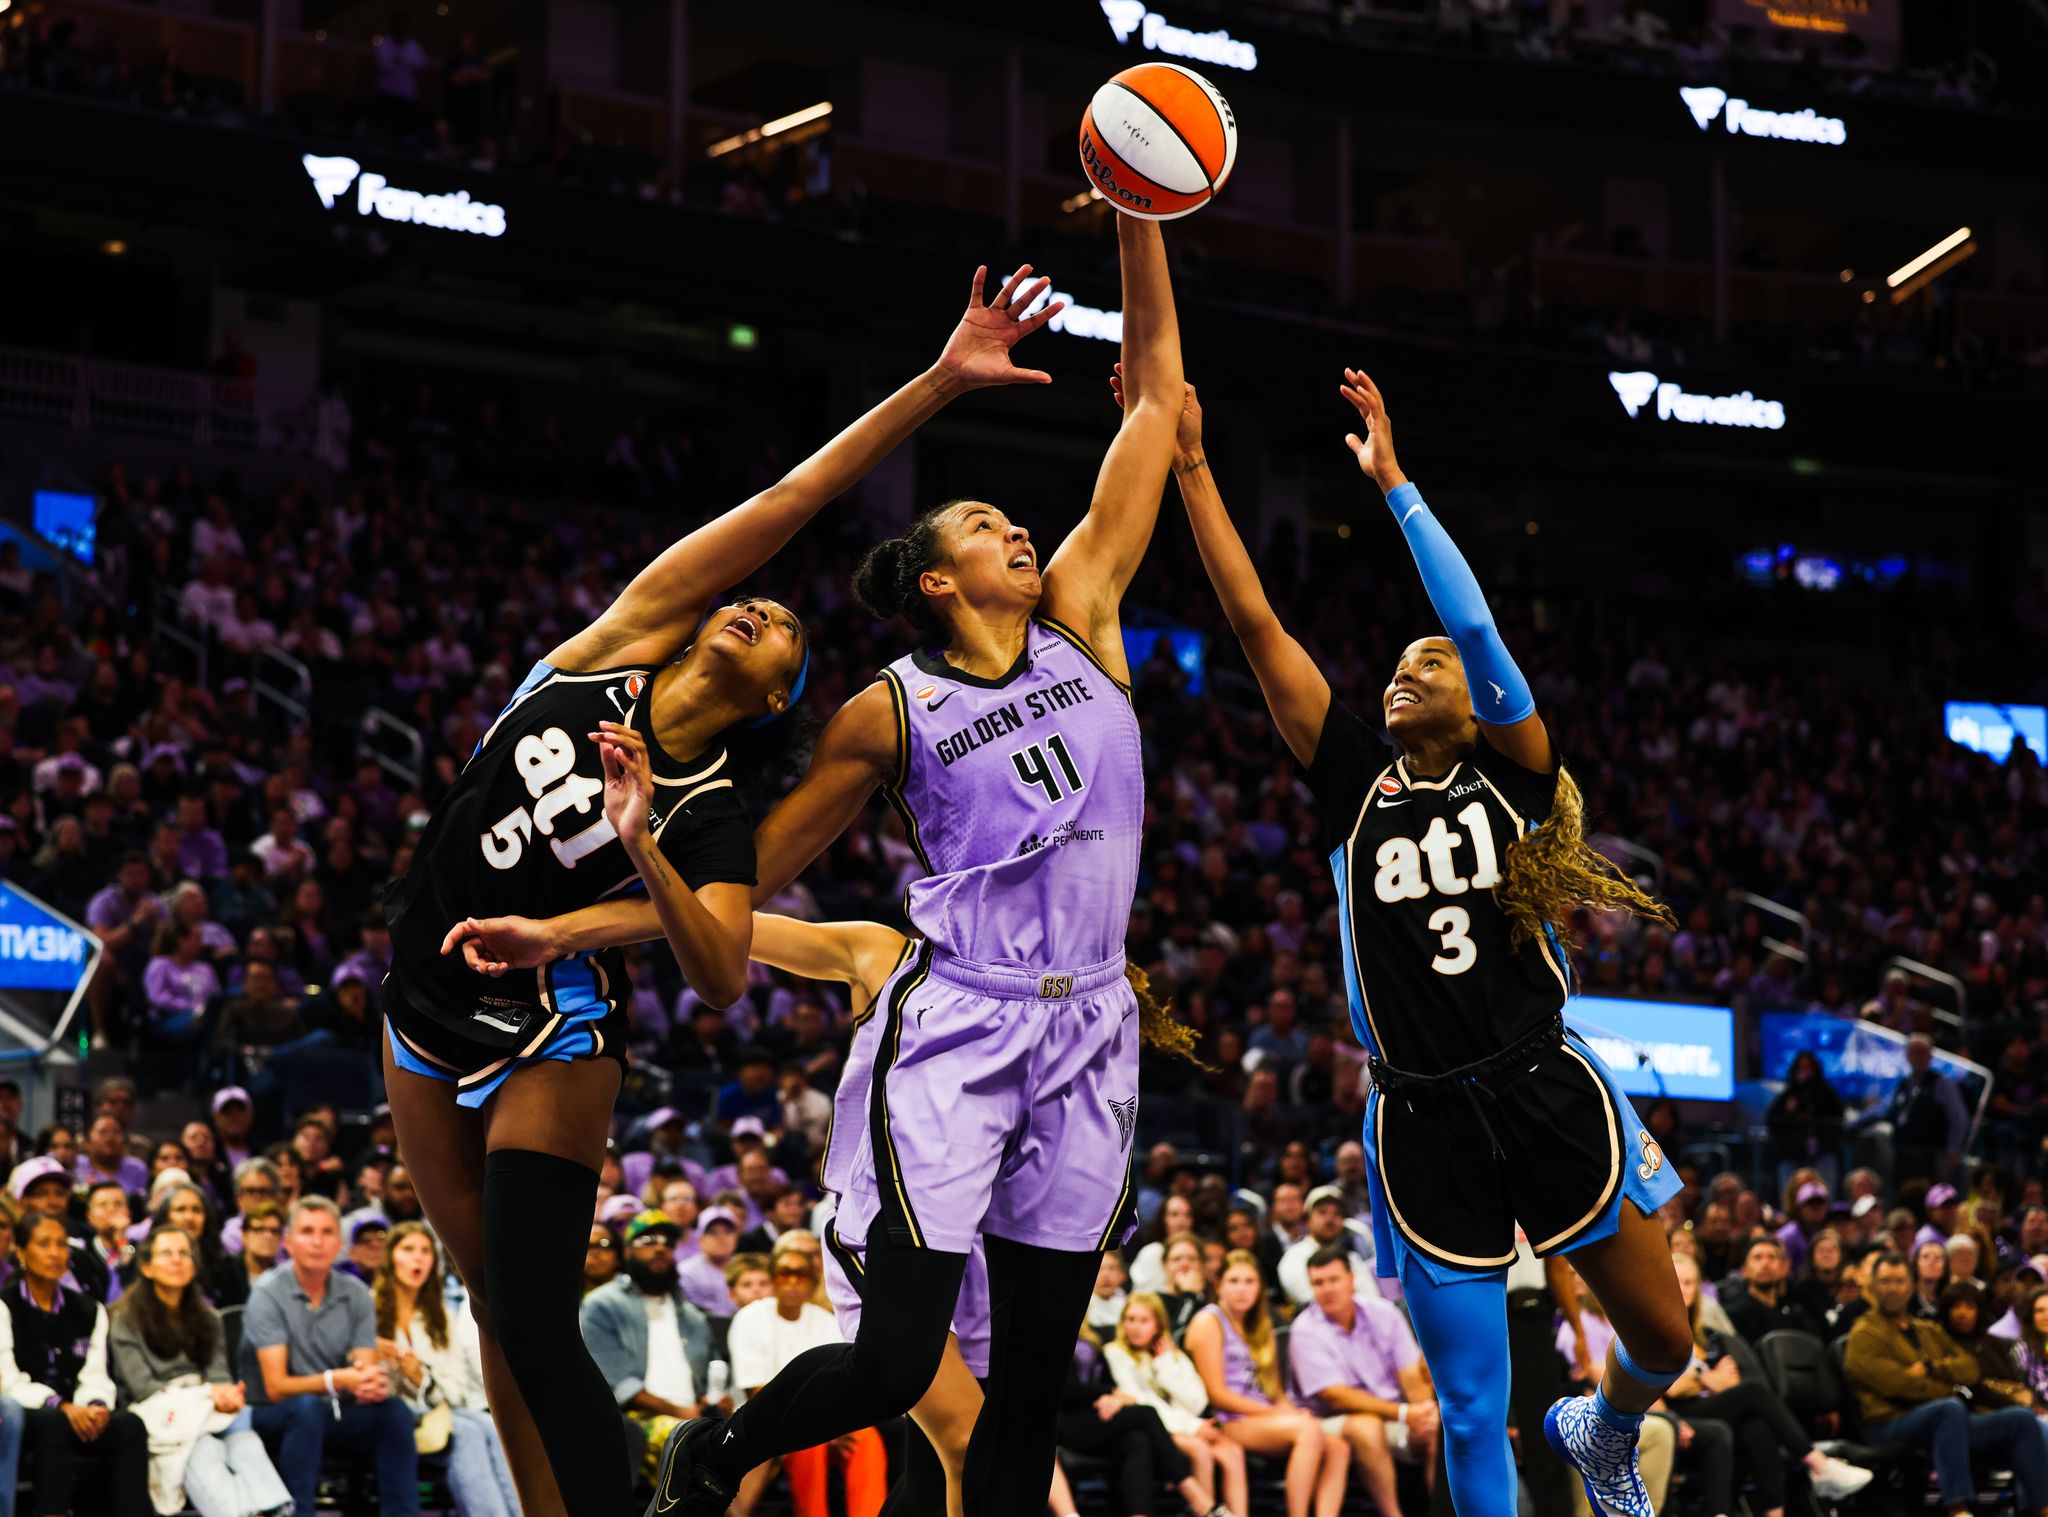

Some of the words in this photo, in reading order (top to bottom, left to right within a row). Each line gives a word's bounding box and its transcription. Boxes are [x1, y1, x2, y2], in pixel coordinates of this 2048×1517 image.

[1081, 127, 1153, 210] Wilson
[357, 172, 507, 237] Fanatics
[1048, 291, 1123, 344] Fana
[1657, 382, 1786, 430] Fanatics
[1033, 640, 1062, 659] freedom
[936, 702, 1025, 768] GOLDEN
[1025, 677, 1094, 720] STATE
[514, 727, 619, 869] atl
[1009, 731, 1086, 805] 41
[480, 805, 533, 870] 5
[1374, 801, 1503, 904] atl
[1428, 905, 1478, 976] 3
[1040, 975, 1074, 999] GSV
